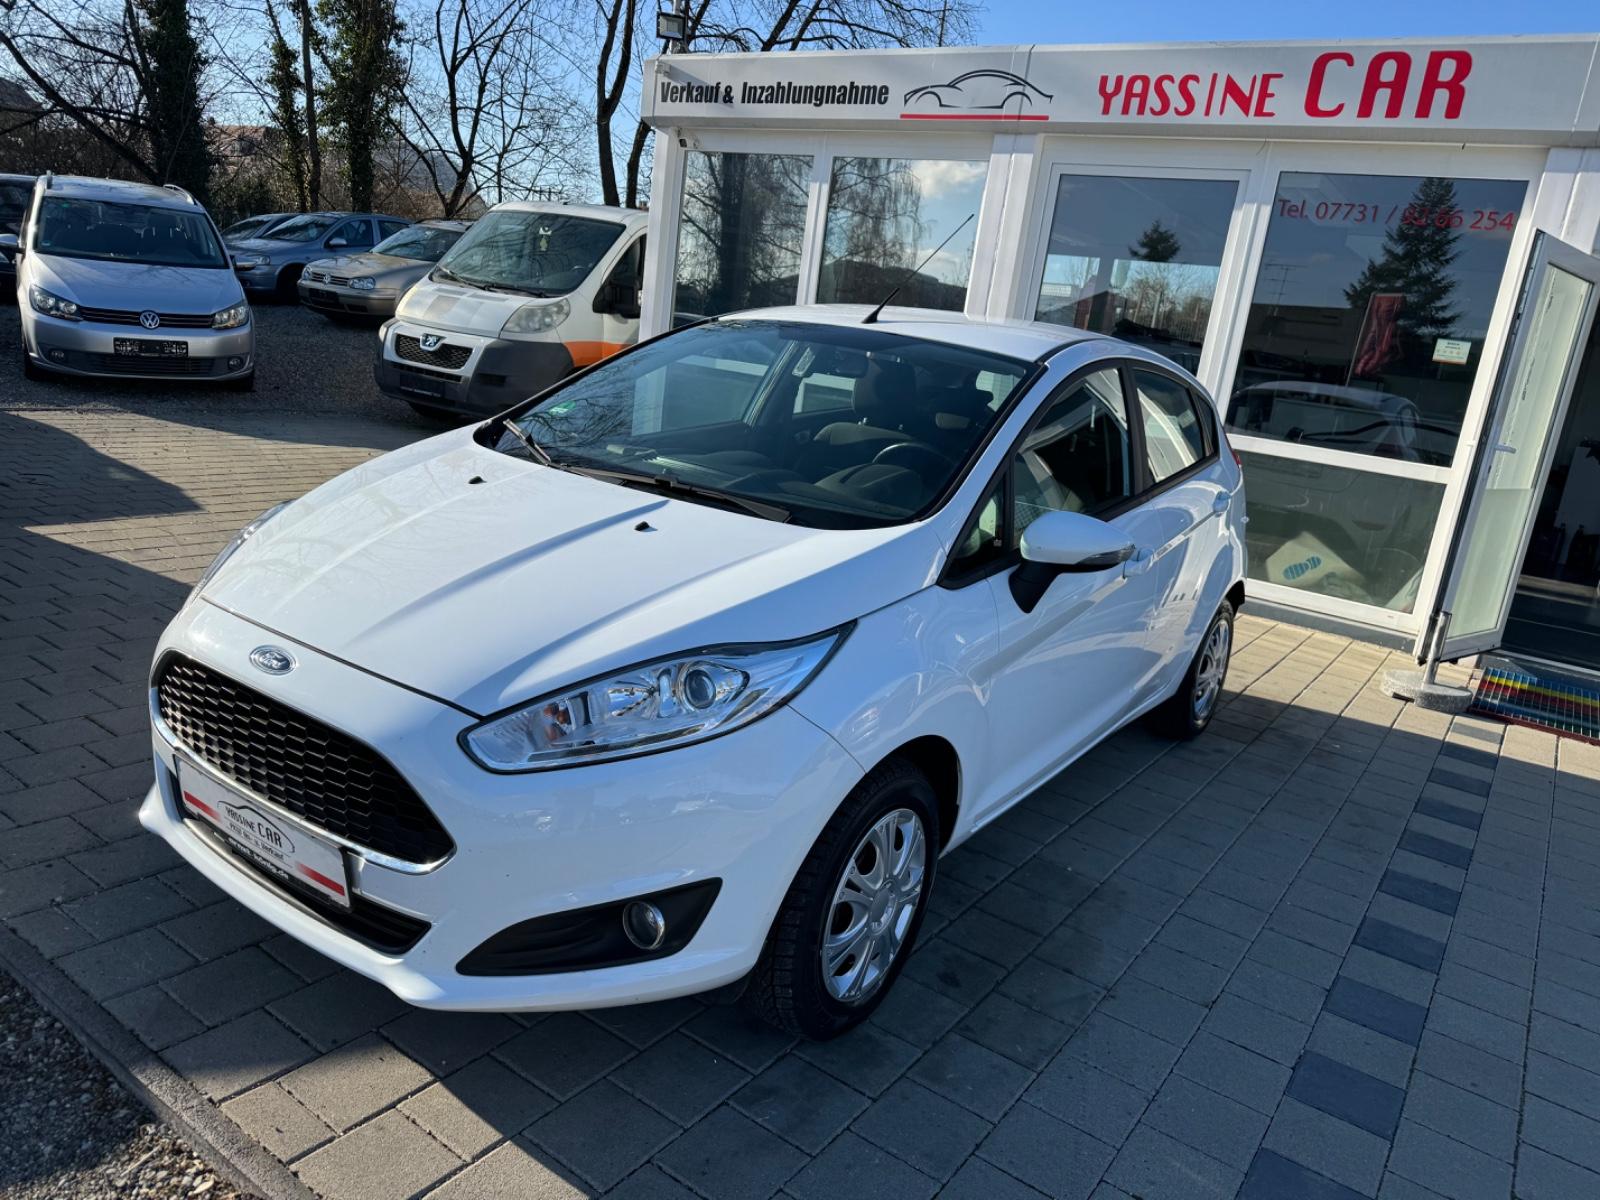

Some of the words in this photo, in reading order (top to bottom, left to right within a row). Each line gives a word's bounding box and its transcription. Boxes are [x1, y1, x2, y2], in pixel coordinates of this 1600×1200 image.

[661, 82, 721, 104] Verkauf
[722, 85, 734, 104] &
[741, 82, 890, 107] Inzahlungnahme
[1098, 72, 1284, 117] YASSINE
[1304, 50, 1473, 119] CAR
[1278, 199, 1308, 219] Tel.
[1315, 201, 1379, 223] 07731
[1469, 207, 1515, 231] 254
[257, 822, 283, 848] CAR
